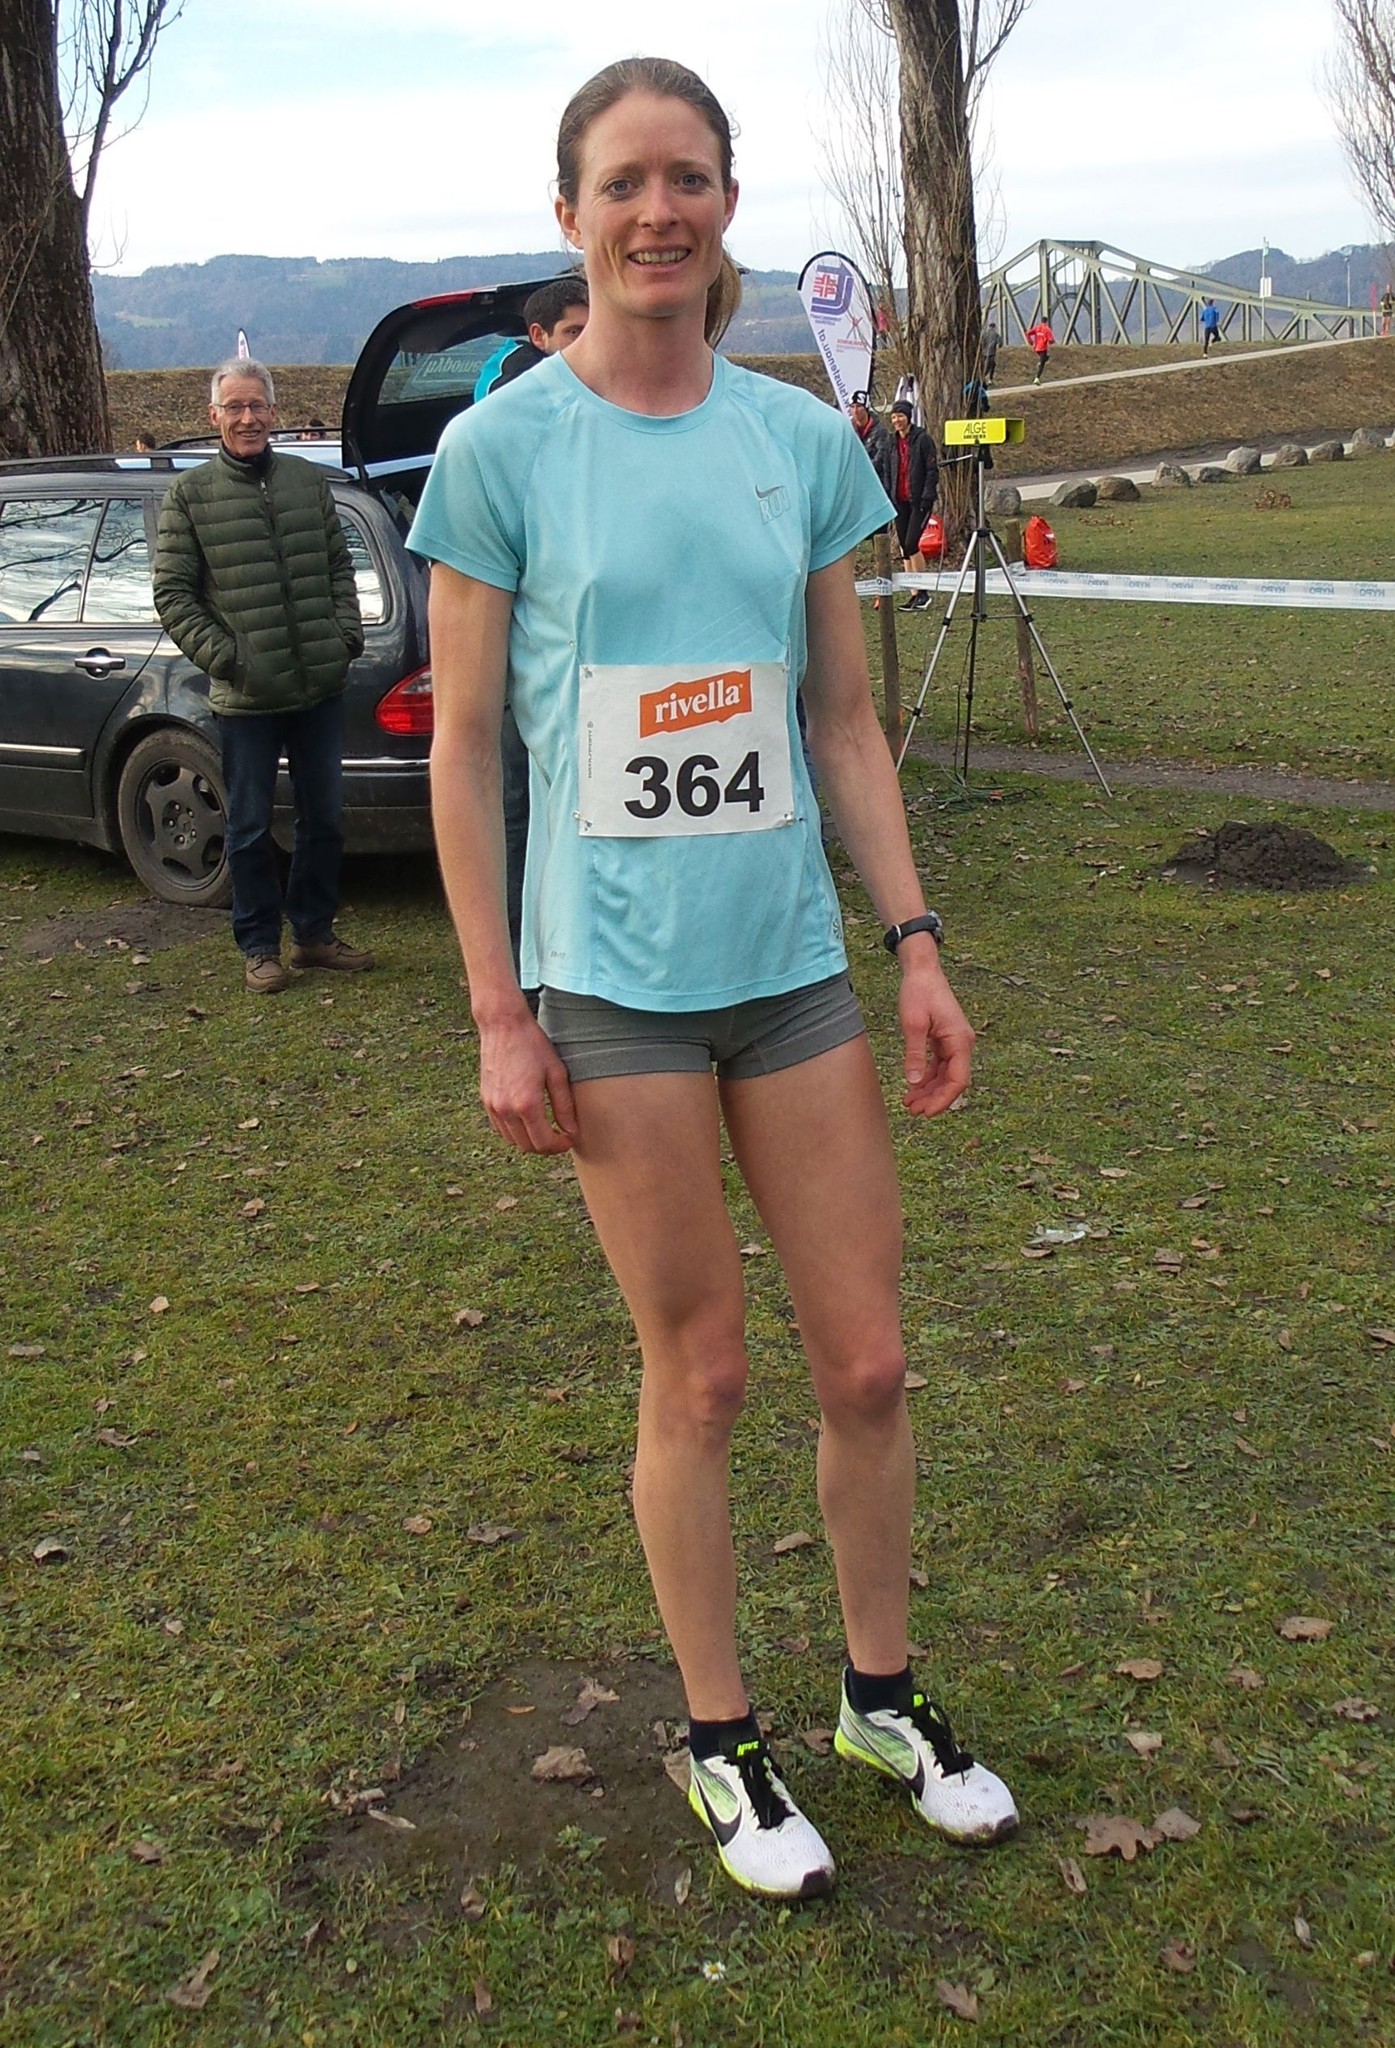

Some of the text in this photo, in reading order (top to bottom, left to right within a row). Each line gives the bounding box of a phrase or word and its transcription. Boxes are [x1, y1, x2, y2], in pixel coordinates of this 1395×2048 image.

[963, 422, 987, 434] ALGE
[654, 678, 741, 724] rivella
[623, 750, 765, 819] 364
